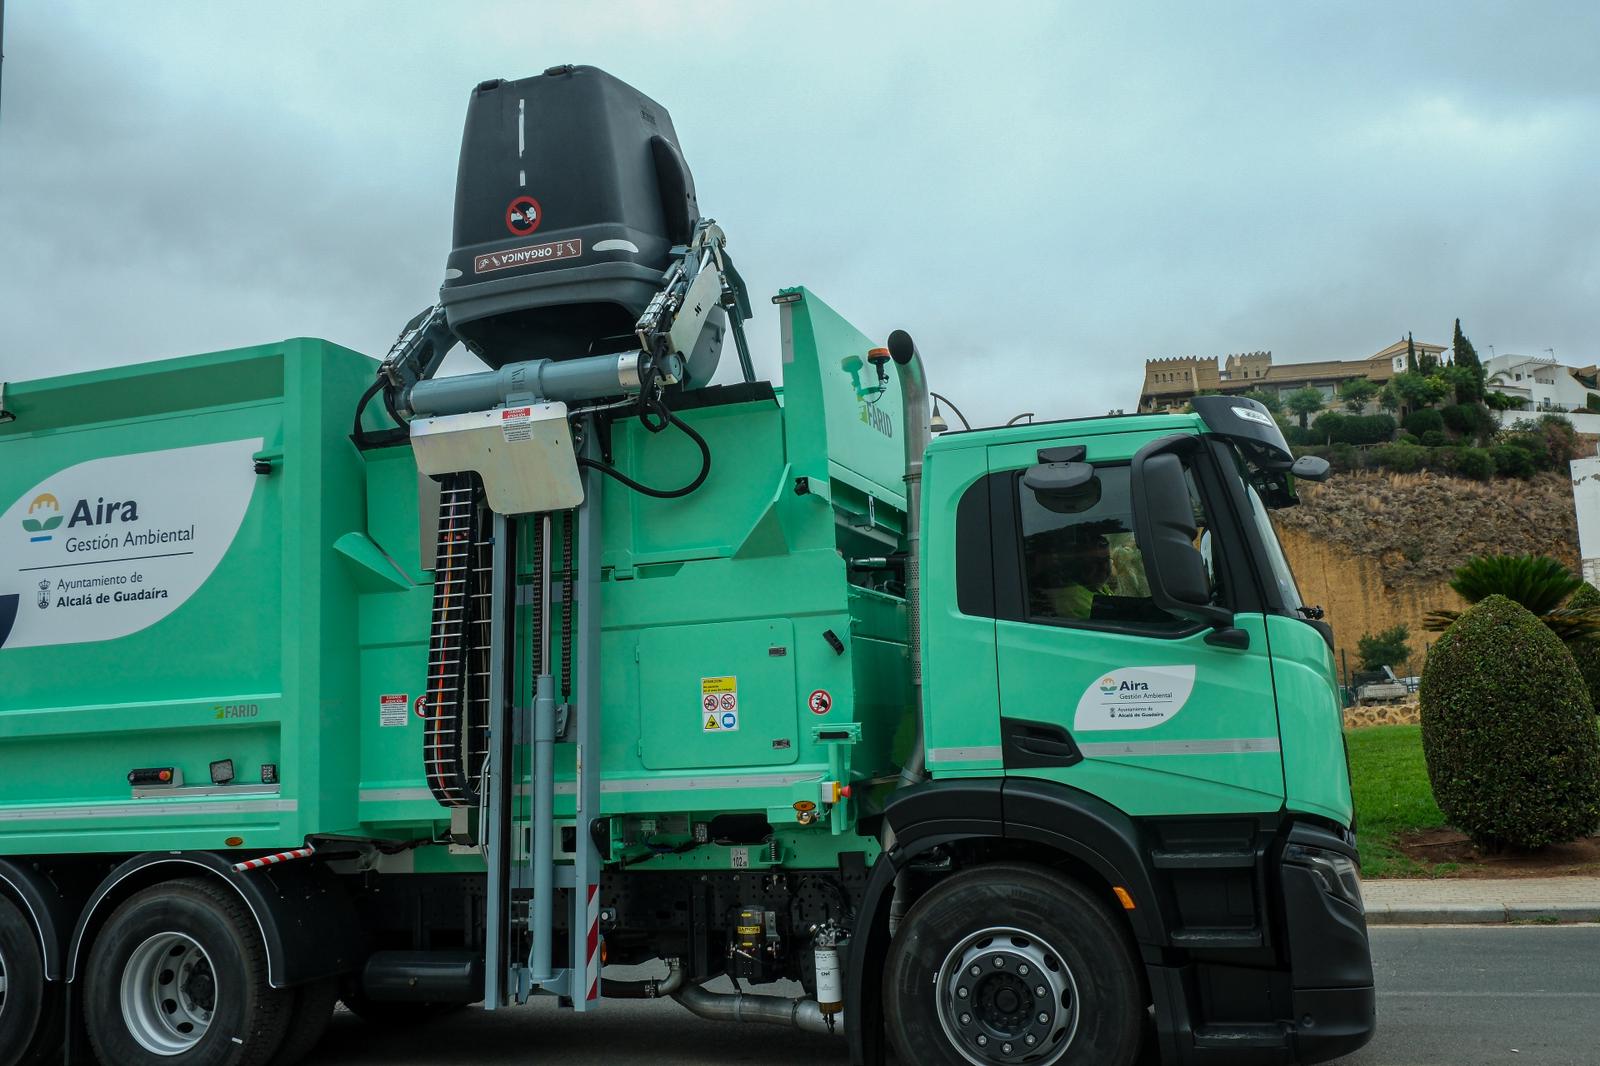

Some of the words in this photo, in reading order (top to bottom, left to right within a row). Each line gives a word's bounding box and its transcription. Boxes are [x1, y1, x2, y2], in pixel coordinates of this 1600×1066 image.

[501, 248, 552, 263] ORGÁNICA
[867, 401, 893, 438] FARID
[67, 496, 139, 529] Aira
[65, 534, 119, 553] Gestión
[123, 525, 195, 547] Ambiental
[57, 575, 127, 592] Ayuntamiento
[130, 571, 143, 583] de
[56, 592, 93, 608] Alcalá
[95, 590, 111, 604] de
[114, 585, 169, 603] Guadaíra
[1120, 680, 1149, 691] Aira
[225, 704, 258, 719] FARID
[733, 856, 743, 867] 102
